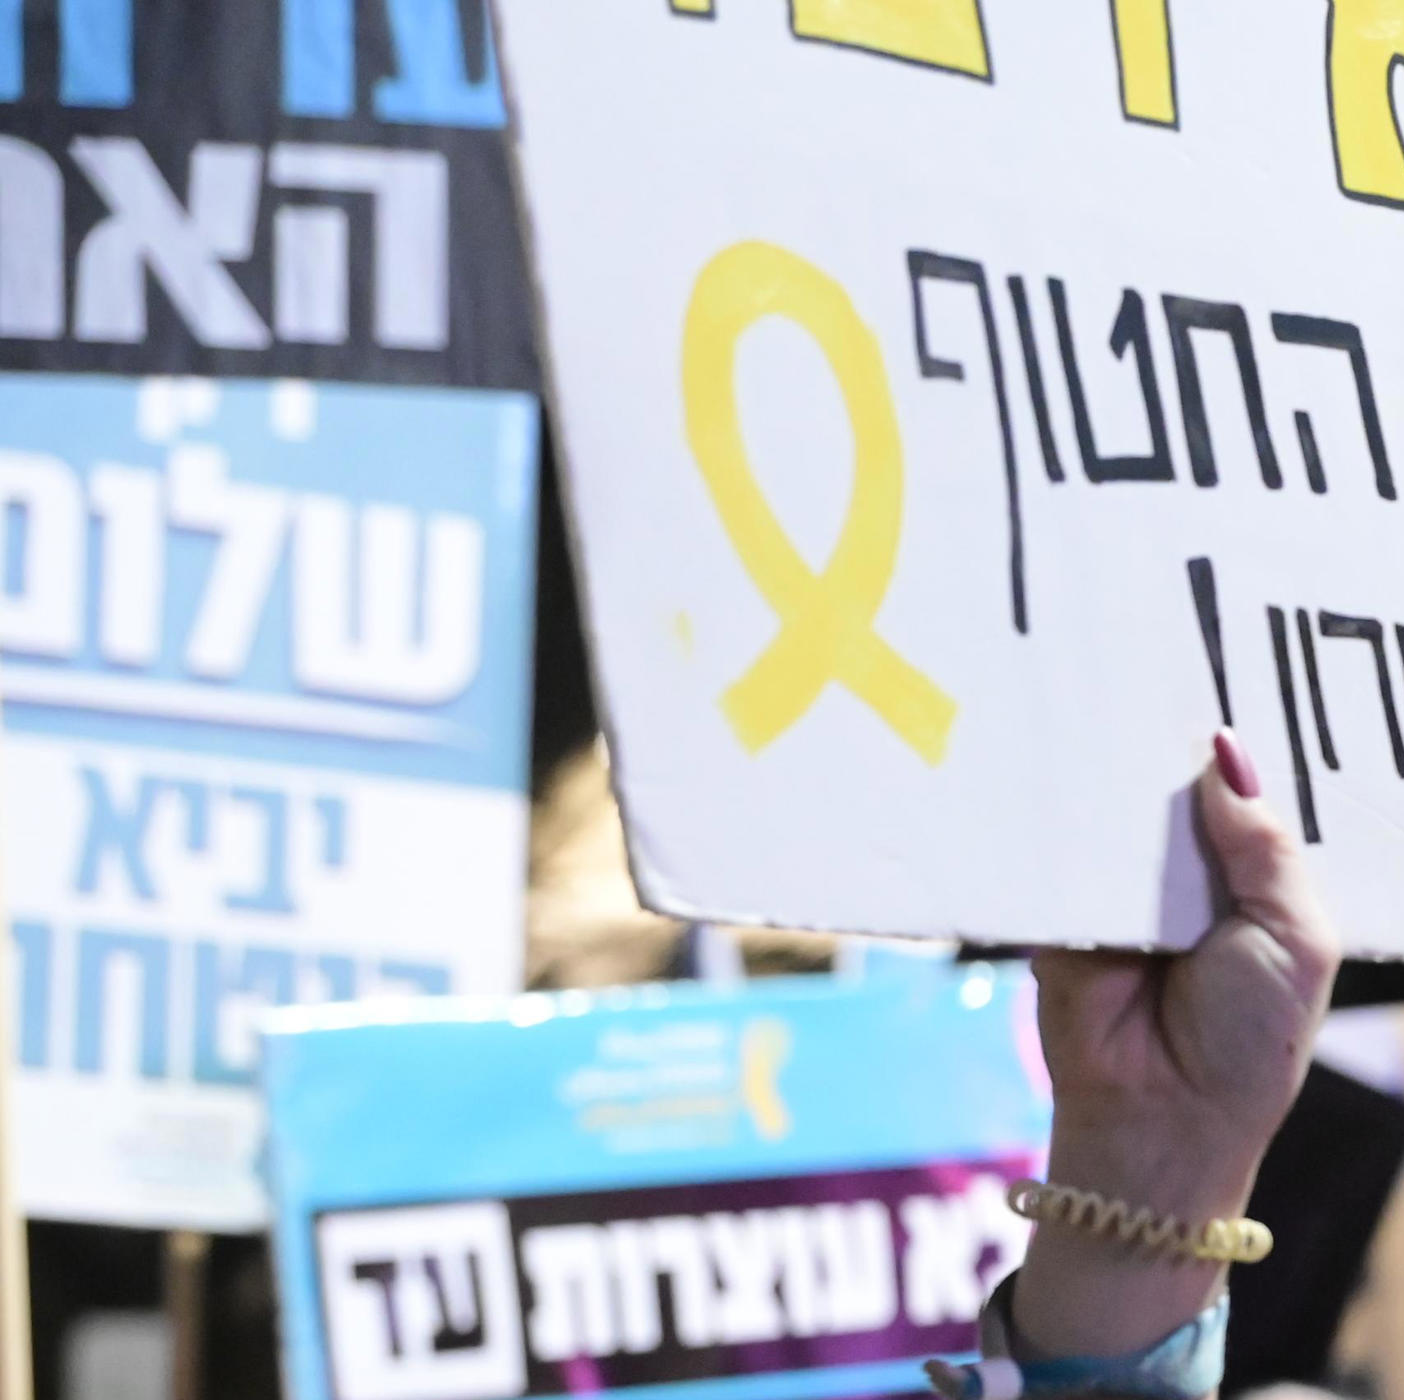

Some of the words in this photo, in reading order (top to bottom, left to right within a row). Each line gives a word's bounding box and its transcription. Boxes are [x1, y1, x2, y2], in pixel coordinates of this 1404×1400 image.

[906, 248, 1398, 636] החטוף
[73, 765, 350, 916] יביא
[352, 1248, 485, 1358] עד
